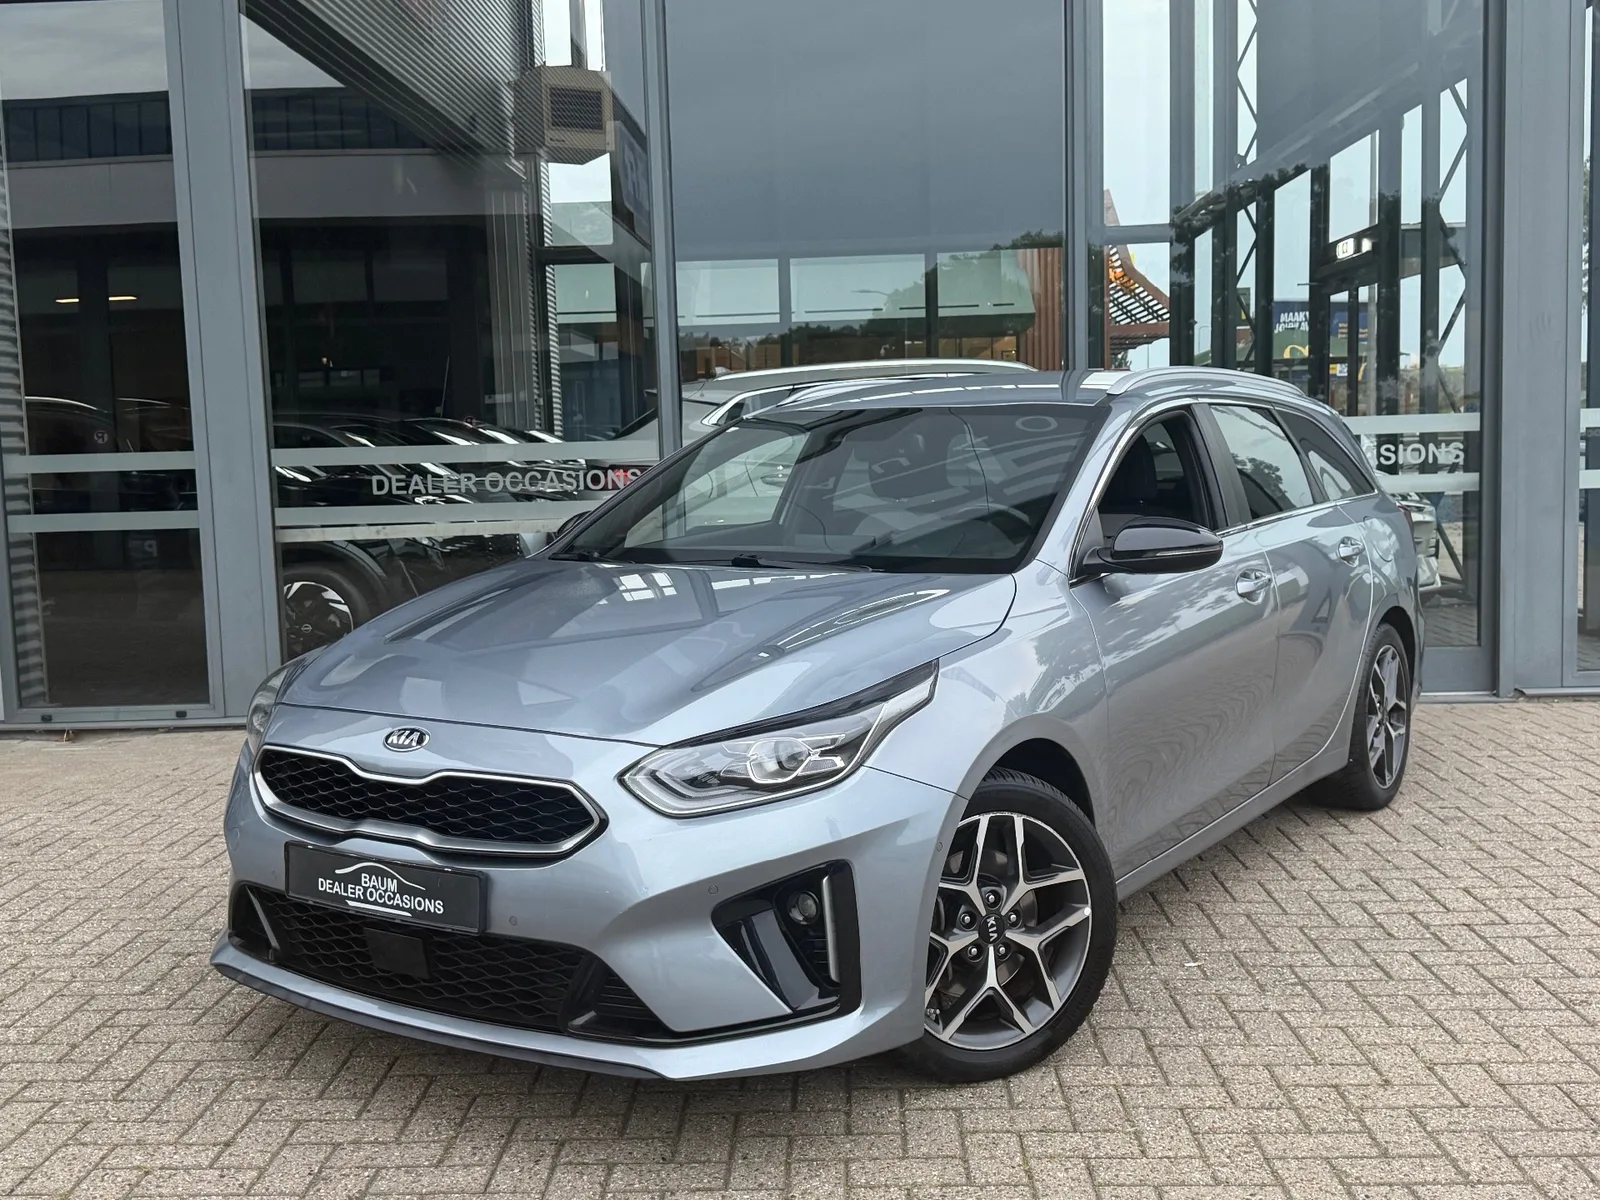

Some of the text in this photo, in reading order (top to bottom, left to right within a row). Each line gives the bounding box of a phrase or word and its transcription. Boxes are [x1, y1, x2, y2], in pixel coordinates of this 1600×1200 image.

[1379, 441, 1465, 465] SIONS
[371, 473, 477, 496] DEALER
[387, 730, 421, 747] KIA
[361, 873, 398, 893] BAUM
[318, 877, 444, 914] DEALER OCCASIONS
[986, 916, 998, 942] KIA
